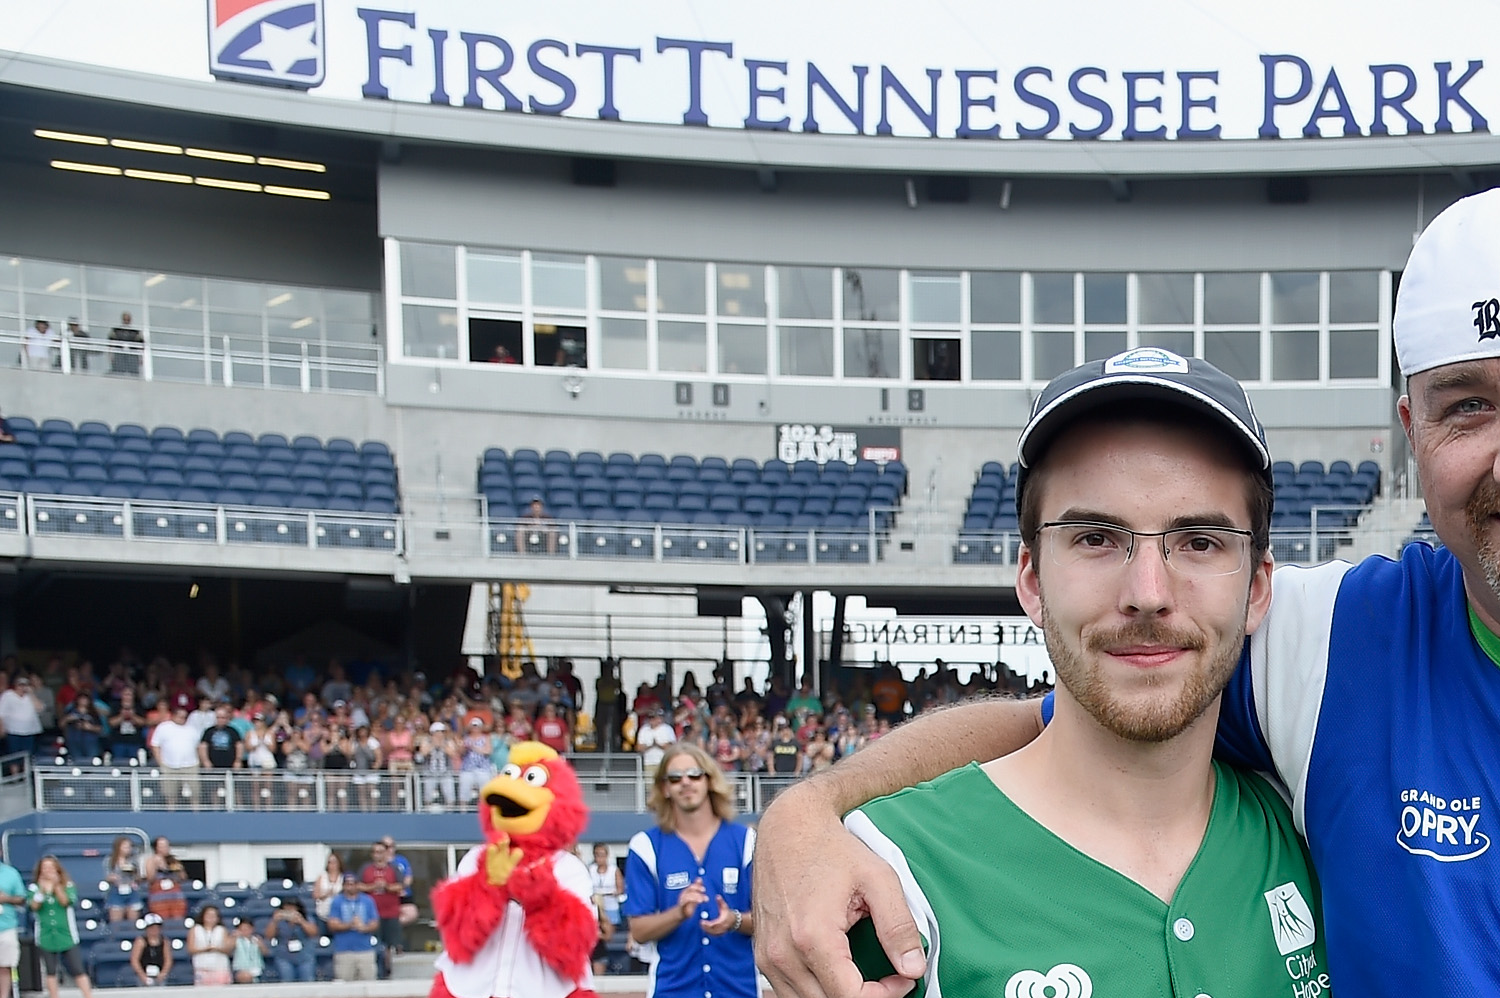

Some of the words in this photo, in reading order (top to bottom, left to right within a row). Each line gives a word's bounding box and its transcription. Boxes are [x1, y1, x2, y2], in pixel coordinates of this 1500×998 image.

[356, 7, 641, 121] FIRST
[656, 36, 1222, 140] TENNESSEE
[1259, 53, 1491, 139] PARK
[778, 438, 858, 465] GAME
[1400, 789, 1447, 811] GRAND
[1449, 797, 1481, 812] OLE
